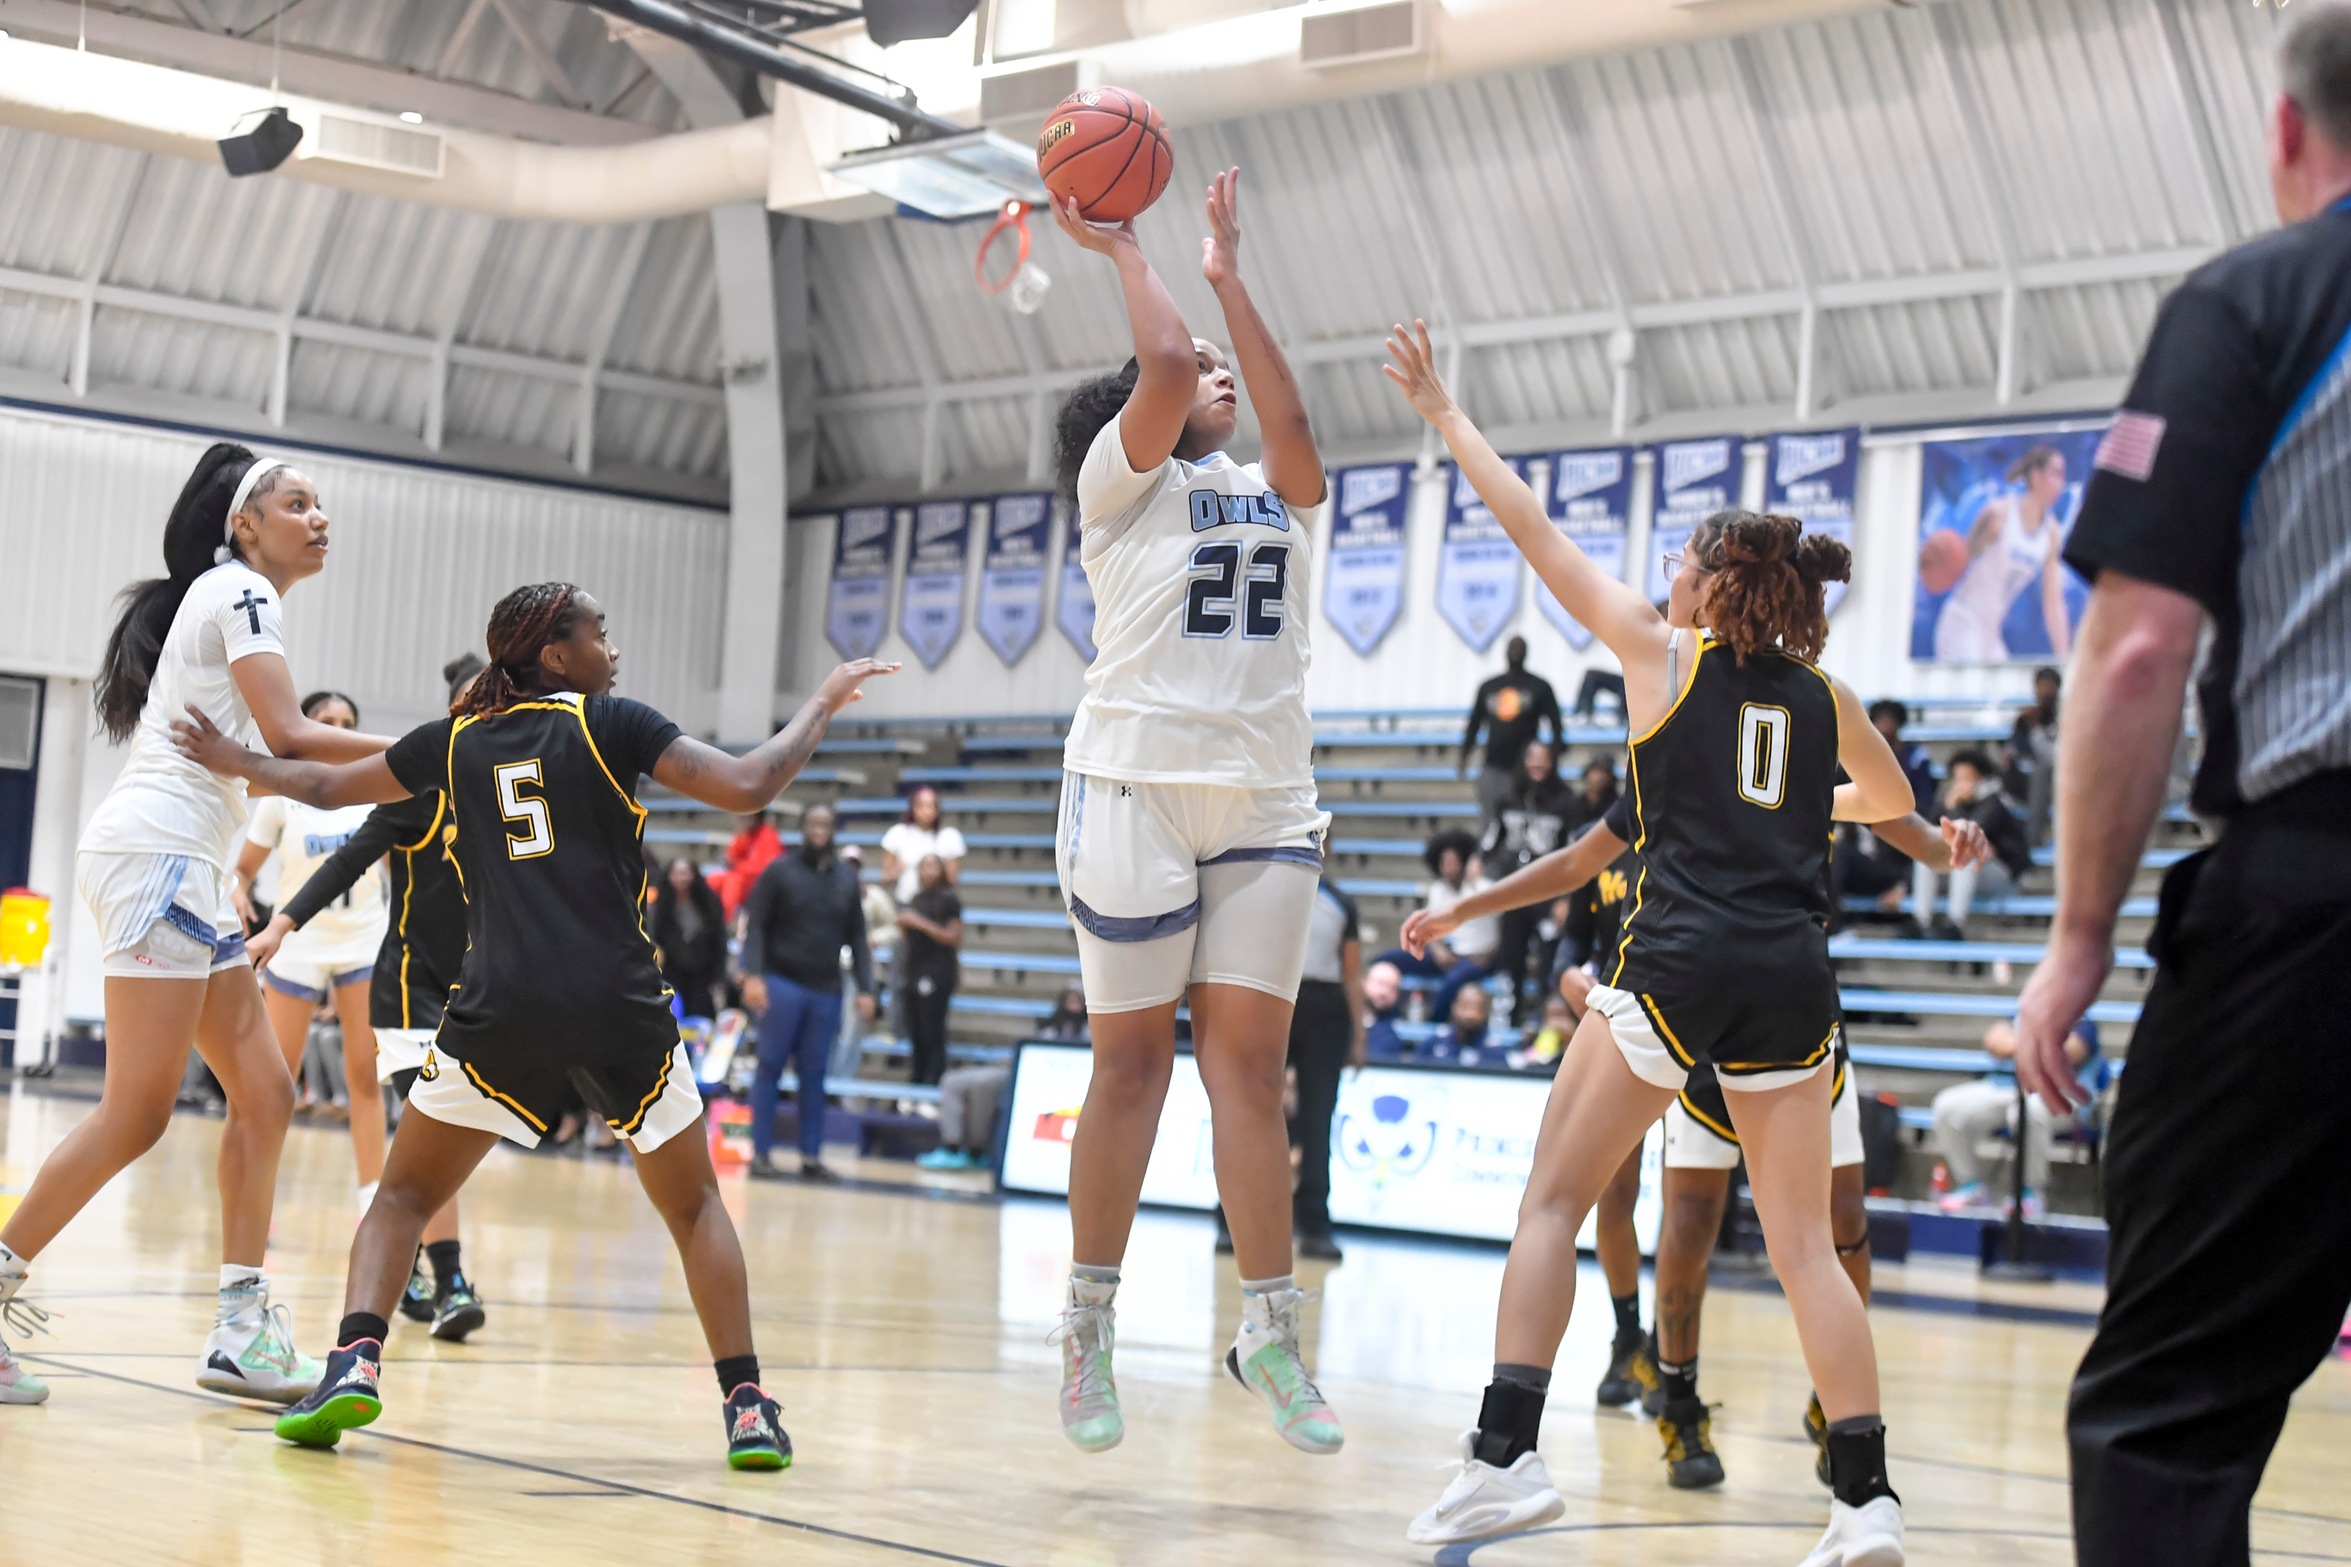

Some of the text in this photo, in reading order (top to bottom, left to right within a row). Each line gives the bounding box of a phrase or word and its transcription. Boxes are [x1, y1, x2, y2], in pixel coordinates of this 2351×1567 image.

[1189, 489, 1290, 532] OWLS
[1181, 540, 1293, 641] 22
[1737, 701, 1792, 811] 0
[493, 757, 555, 861] 5
